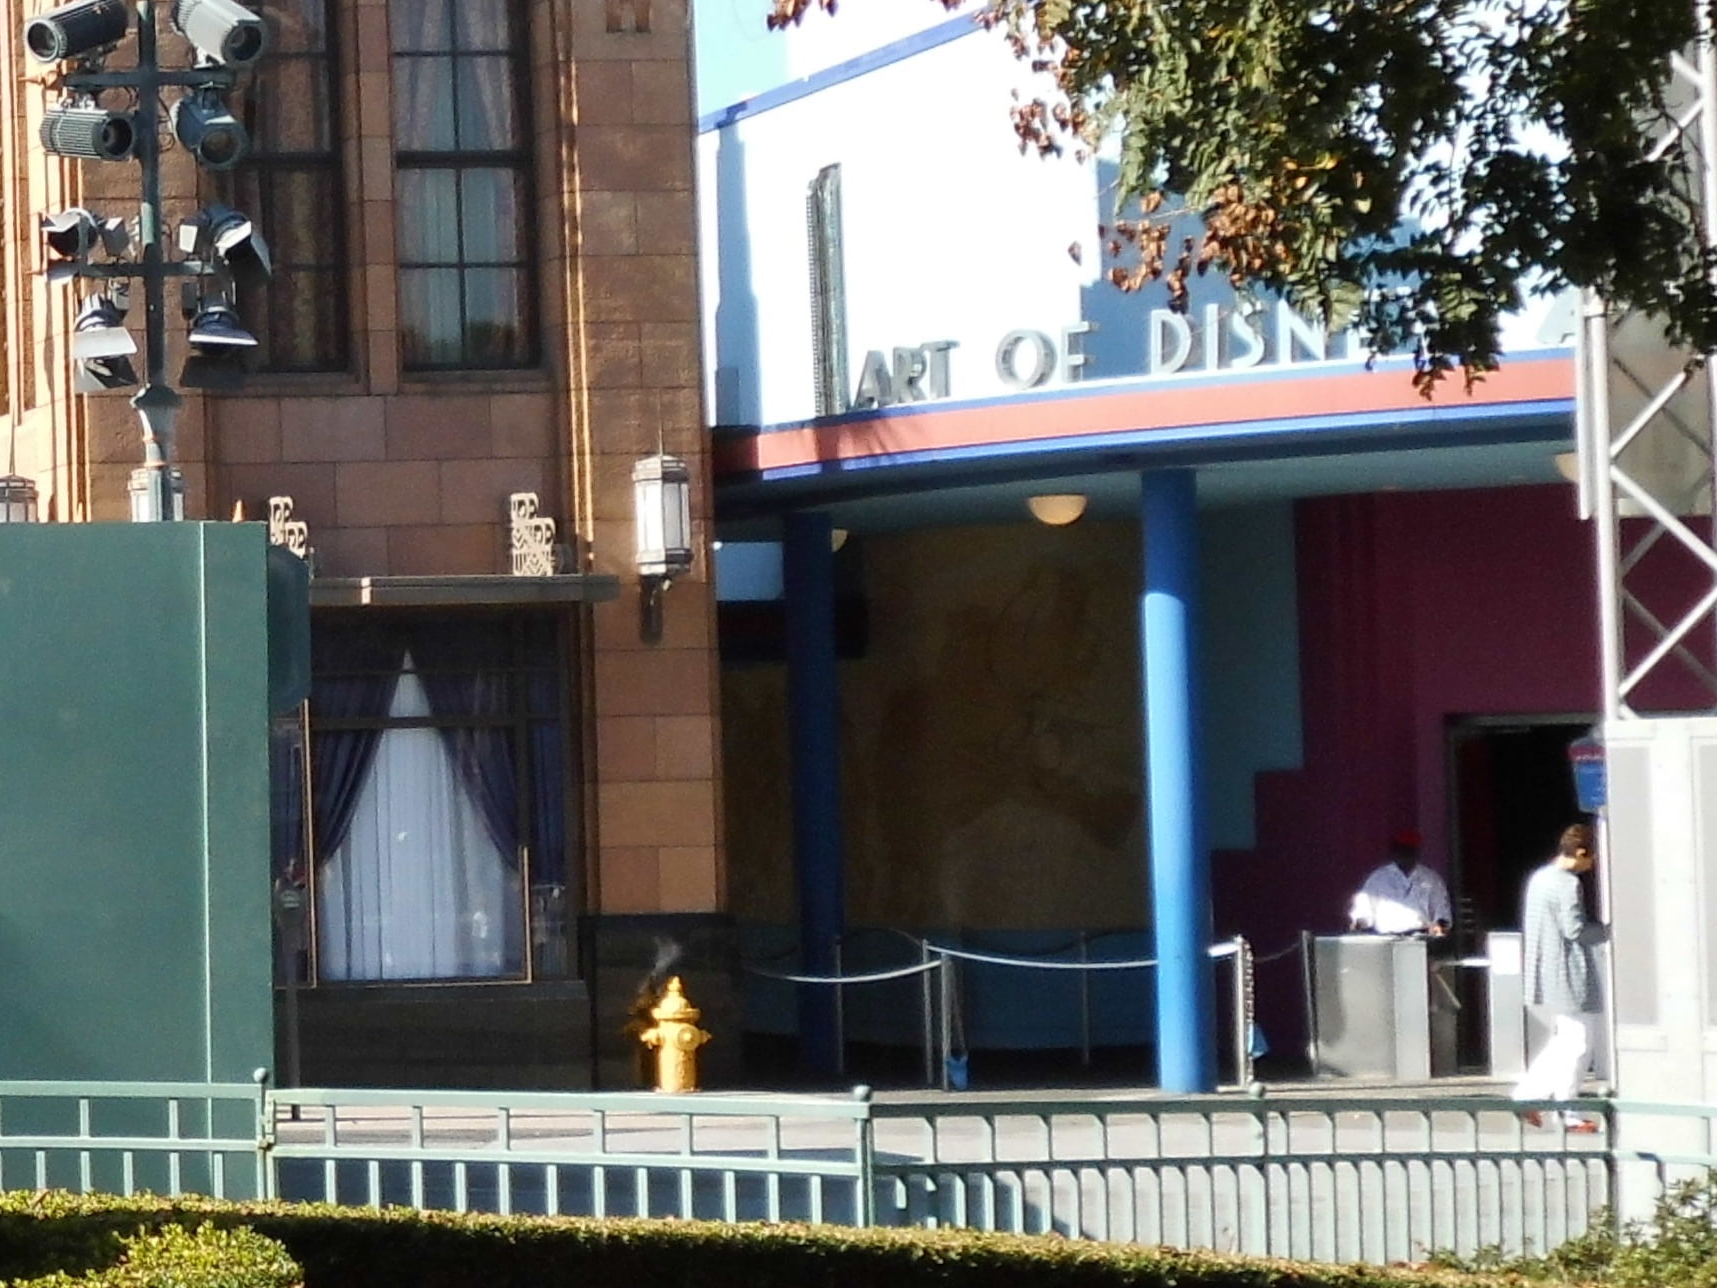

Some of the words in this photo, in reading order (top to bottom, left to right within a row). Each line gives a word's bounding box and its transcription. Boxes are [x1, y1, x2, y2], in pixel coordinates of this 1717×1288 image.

[853, 339, 960, 410] ART
[994, 321, 1095, 390] OF
[1149, 294, 1435, 377] DISNE
